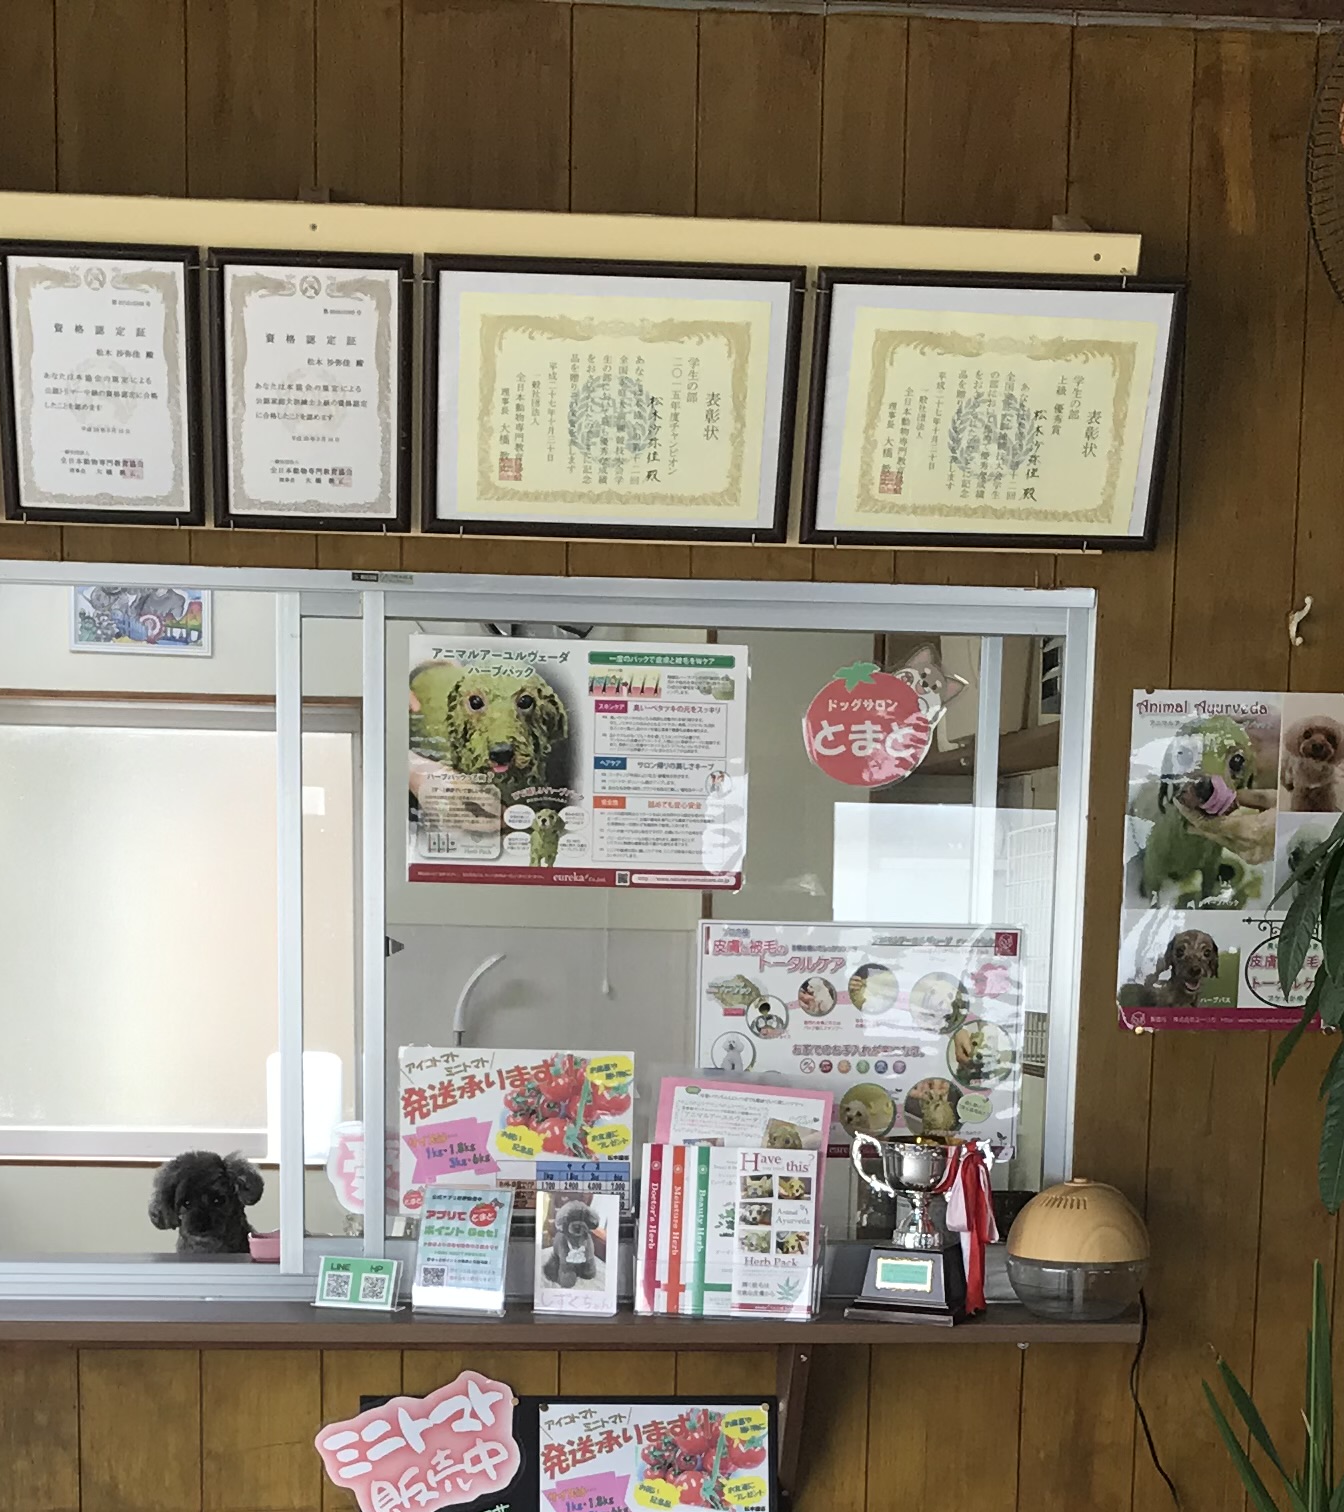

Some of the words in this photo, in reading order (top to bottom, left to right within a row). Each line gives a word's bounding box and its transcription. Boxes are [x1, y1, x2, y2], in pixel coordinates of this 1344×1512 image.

[702, 390, 722, 442] 表彰状
[1080, 409, 1104, 459] 表彰状
[827, 697, 898, 712] ドッグサロン
[1136, 698, 1189, 717] Animal
[813, 719, 917, 758] とまと
[330, 1262, 351, 1272] LINE
[322, 1379, 506, 1479] ミニトマト
